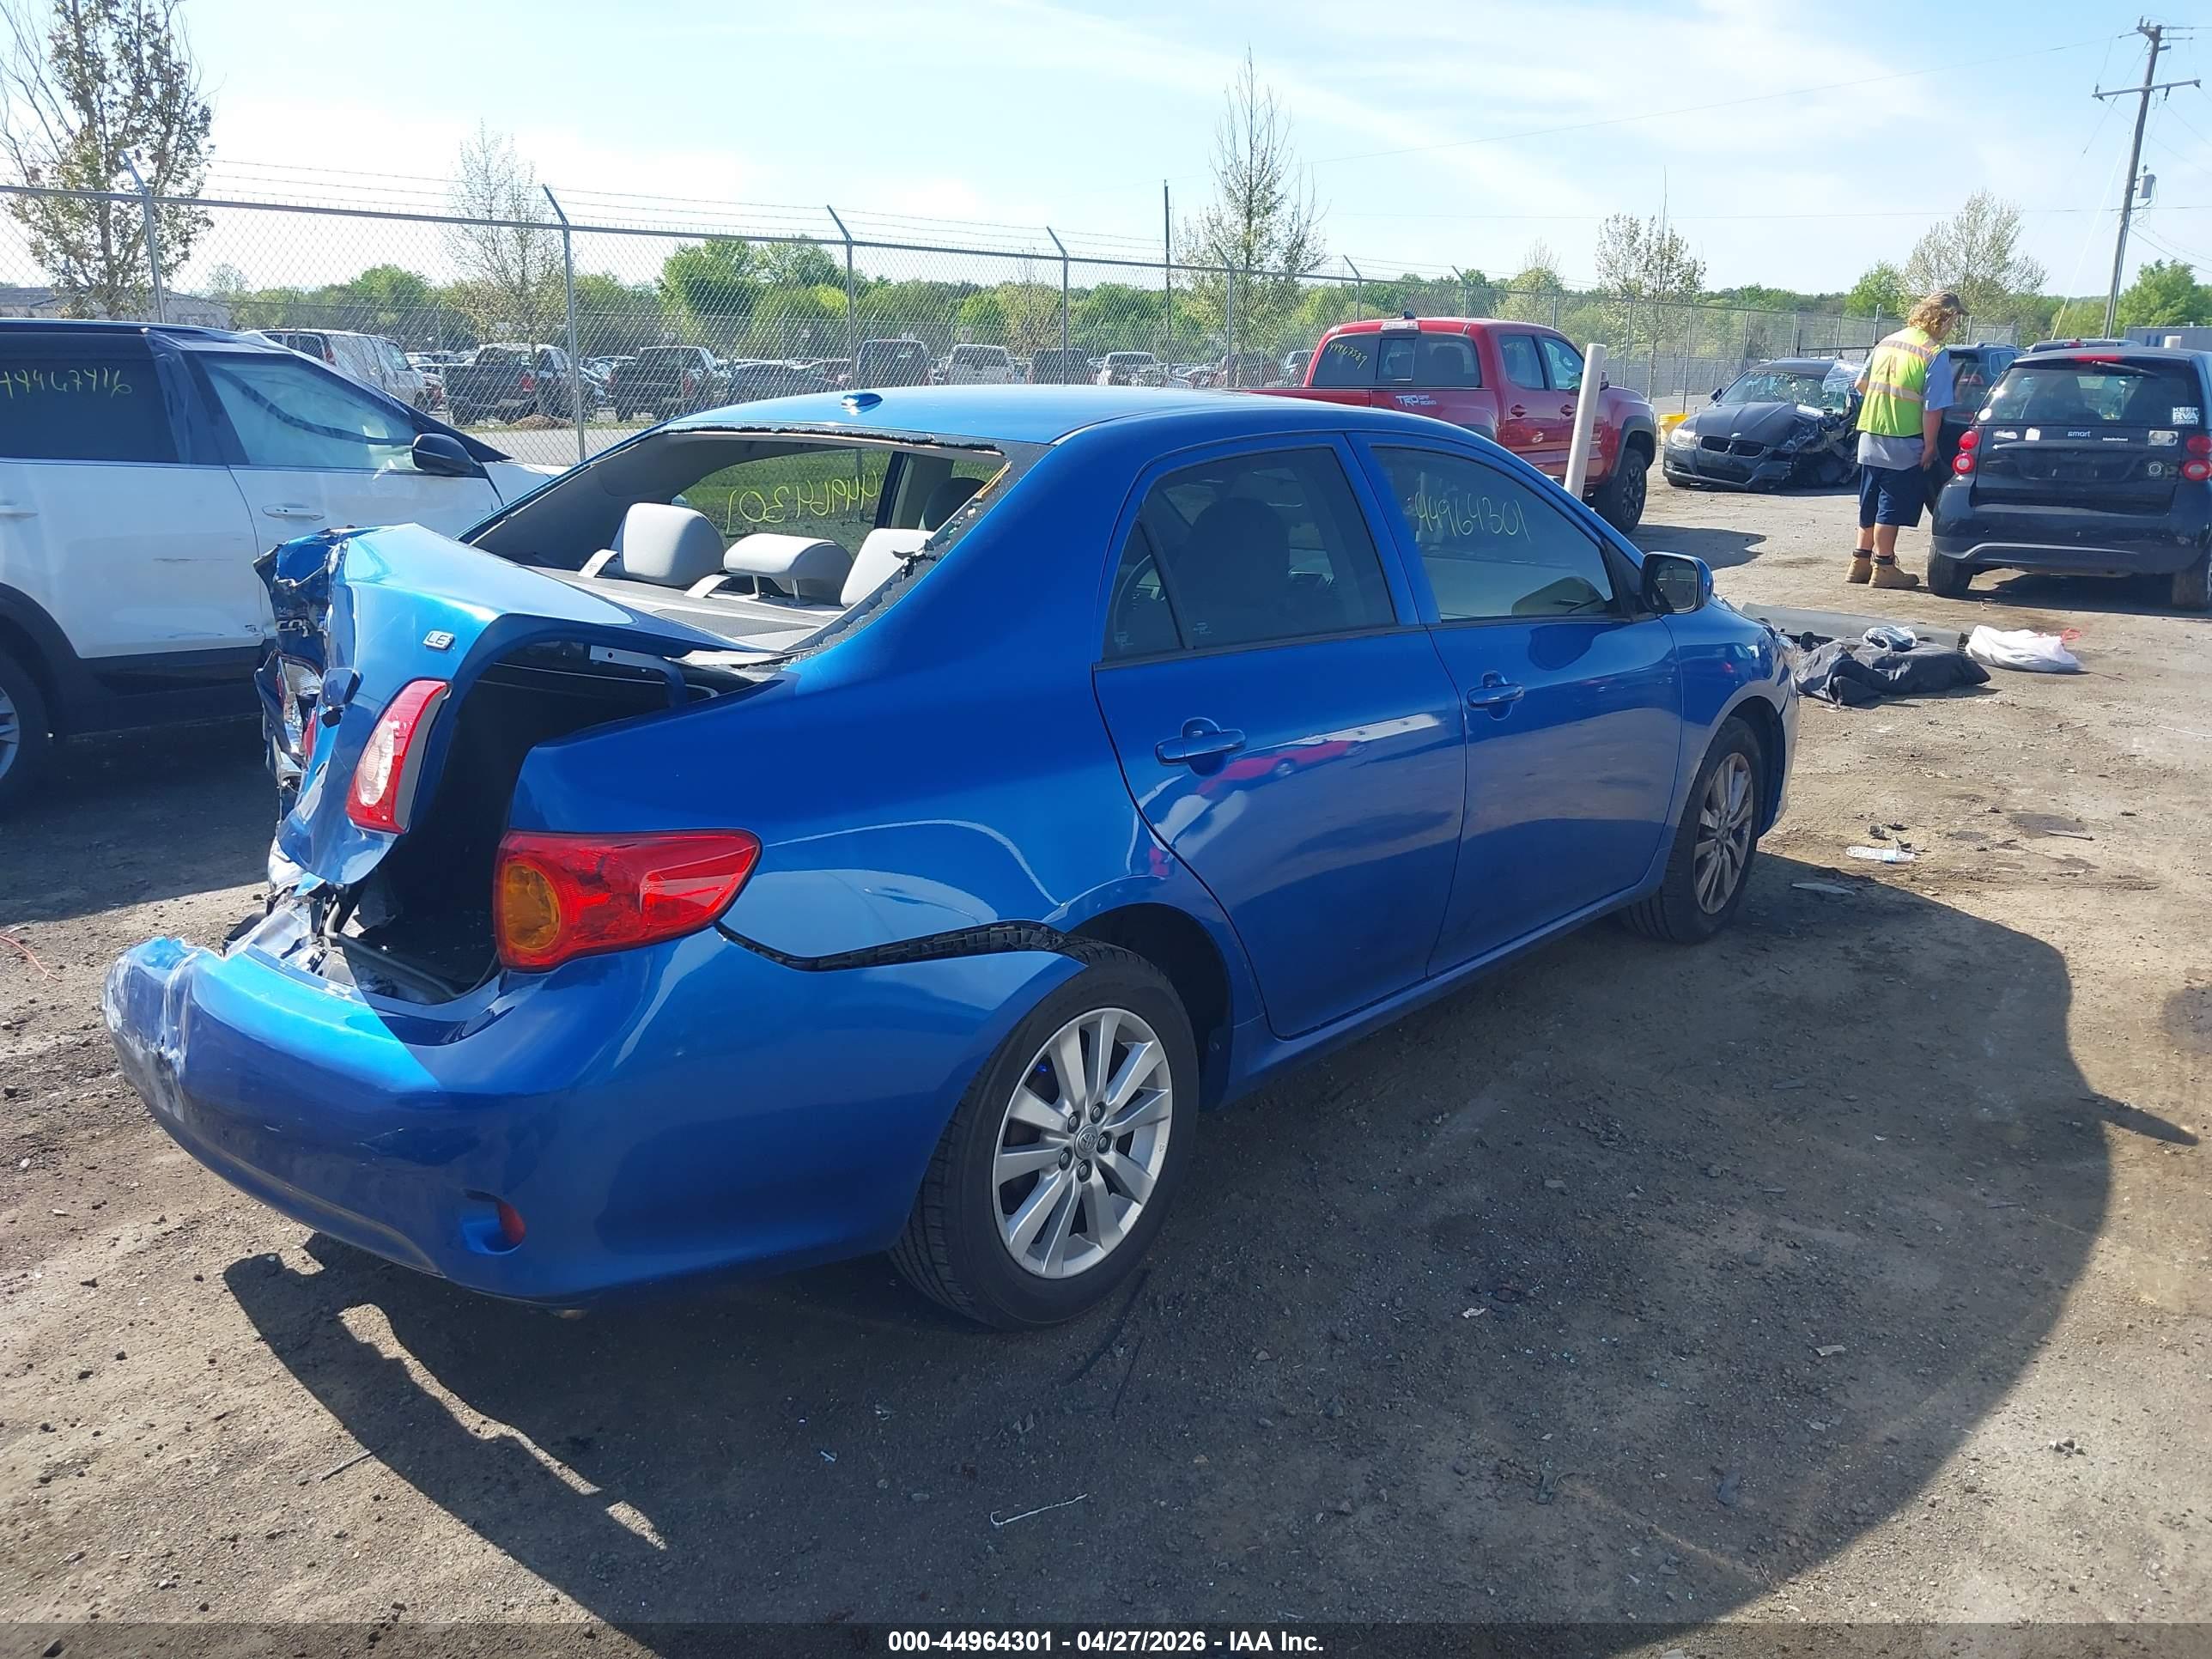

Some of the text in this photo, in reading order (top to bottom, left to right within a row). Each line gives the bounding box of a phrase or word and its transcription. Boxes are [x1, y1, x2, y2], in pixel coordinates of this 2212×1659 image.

[1395, 394, 1419, 407] TRD
[1414, 491, 1531, 543] 44964301
[426, 631, 450, 646] LE
